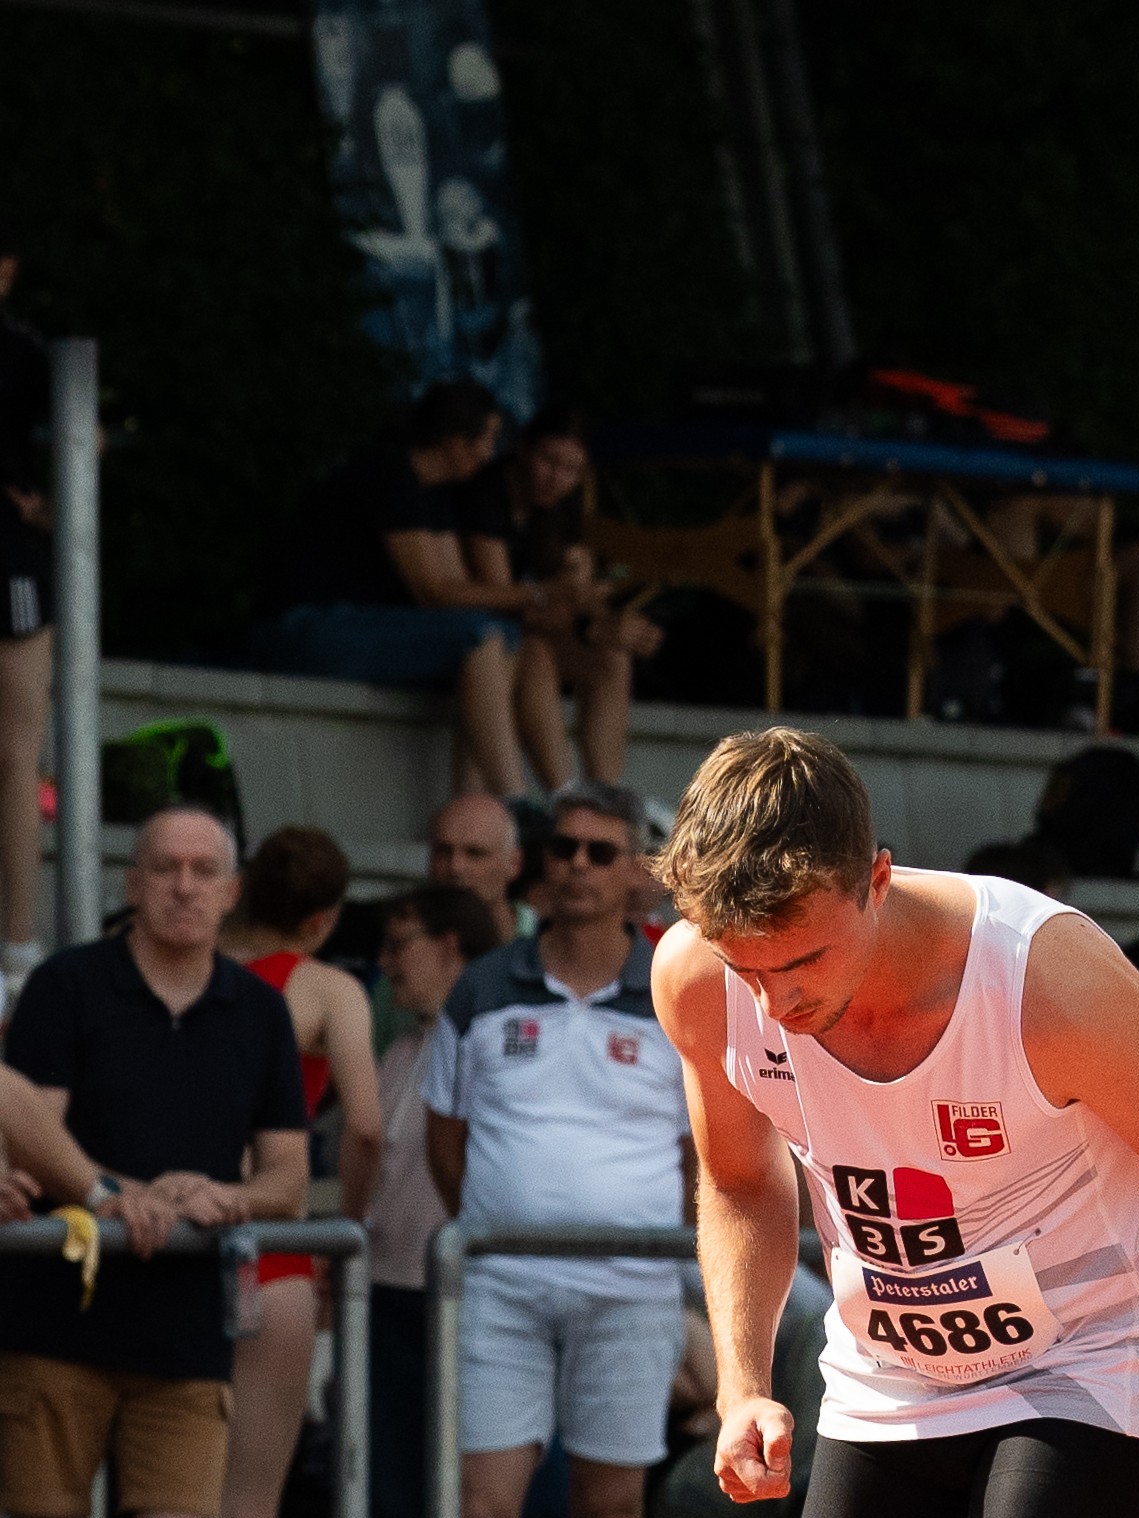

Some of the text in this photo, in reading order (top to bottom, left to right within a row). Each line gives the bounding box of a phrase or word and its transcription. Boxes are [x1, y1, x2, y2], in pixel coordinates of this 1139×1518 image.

[951, 1105, 998, 1118] FILDER
[847, 1175, 880, 1210] K
[918, 1225, 946, 1257] S
[870, 1275, 978, 1298] Peterstaler
[866, 1301, 1035, 1357] 4686
